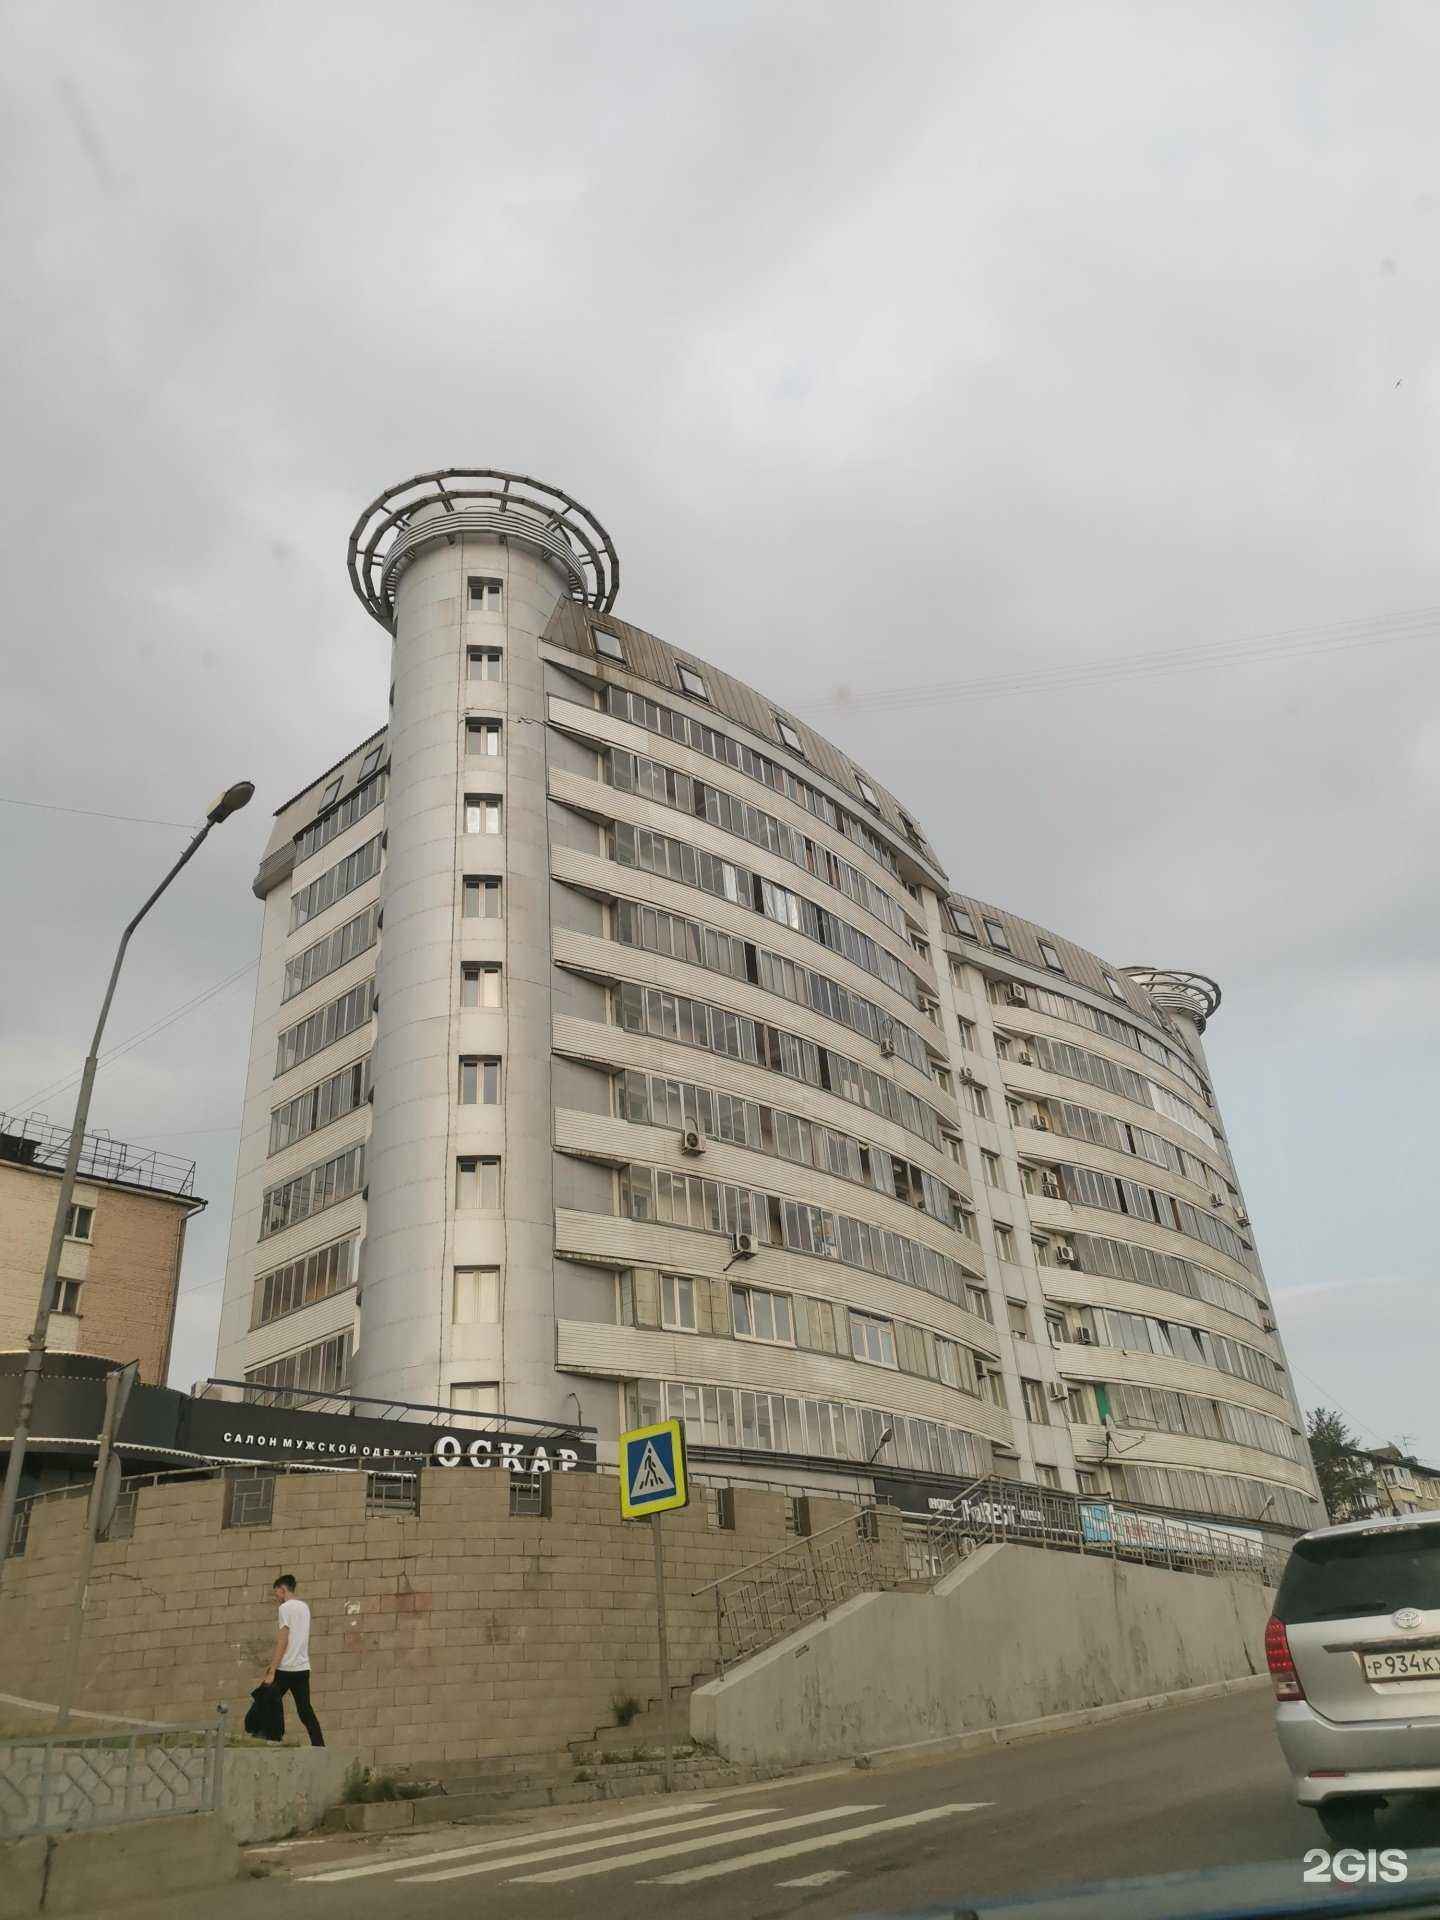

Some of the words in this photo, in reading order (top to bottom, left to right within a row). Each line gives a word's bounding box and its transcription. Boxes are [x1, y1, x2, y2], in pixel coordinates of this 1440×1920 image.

[223, 1432, 277, 1447] САЛОН
[283, 1438, 357, 1455] МУЖСКОЙ
[434, 1436, 578, 1474] ОСКАР
